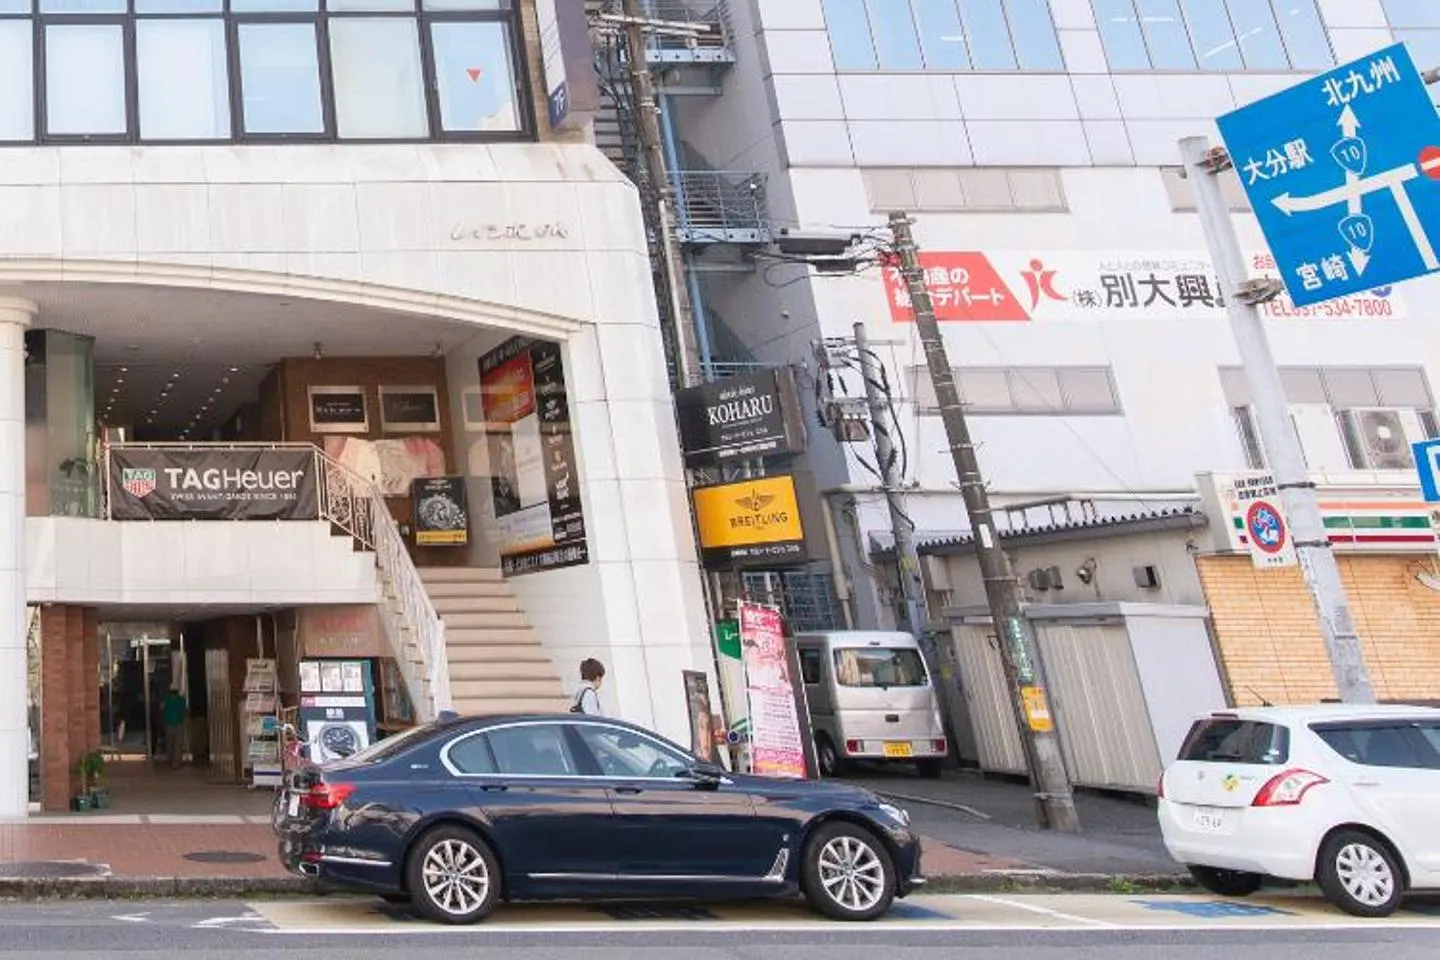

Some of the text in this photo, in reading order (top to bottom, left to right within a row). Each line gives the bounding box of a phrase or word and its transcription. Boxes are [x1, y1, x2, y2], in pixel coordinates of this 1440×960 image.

[1321, 55, 1401, 107] 北九州
[1243, 138, 1314, 185] 大分駅
[1340, 146, 1361, 162] 10
[1348, 224, 1368, 239] 10
[887, 266, 970, 285] 不産の
[1296, 253, 1349, 291] 宮崎
[894, 287, 1005, 307] 総デパート
[707, 394, 773, 425] KOHARU
[729, 511, 789, 529] BREITLING
